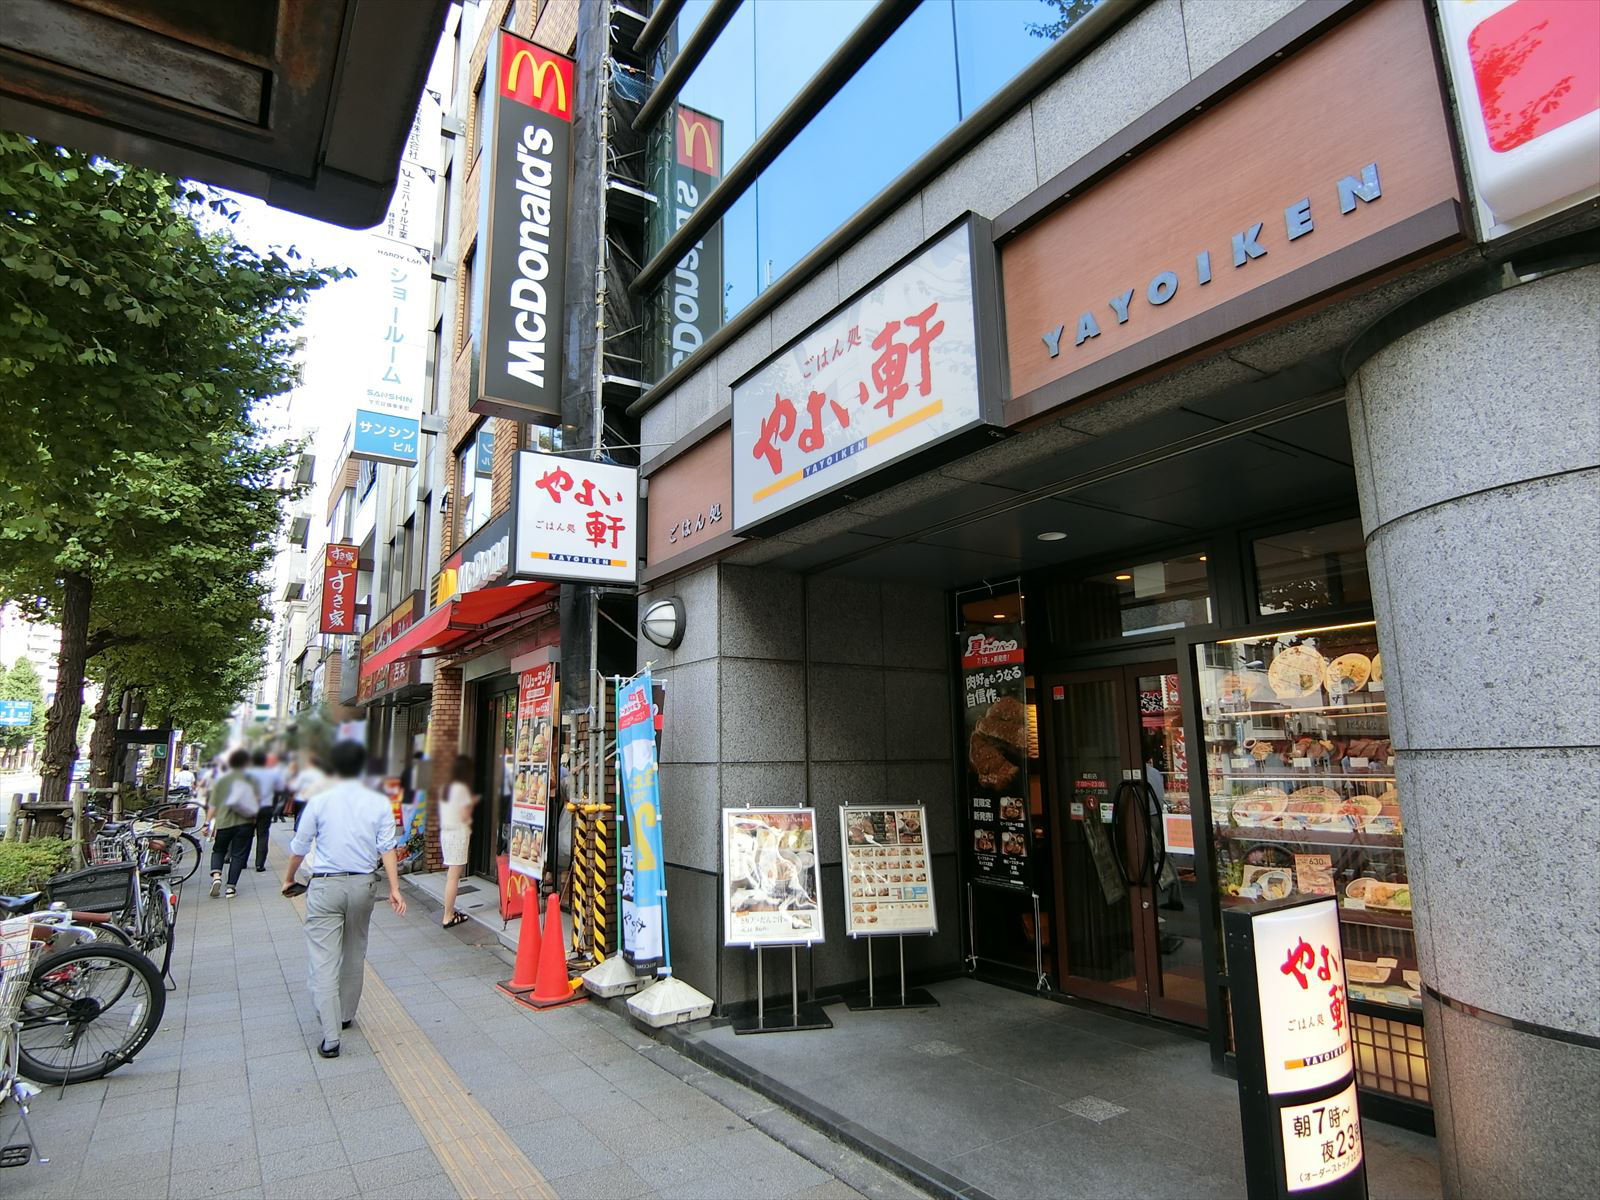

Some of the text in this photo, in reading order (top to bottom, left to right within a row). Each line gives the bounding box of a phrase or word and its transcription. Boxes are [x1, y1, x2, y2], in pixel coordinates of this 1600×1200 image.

[507, 125, 554, 388] McDonald's
[1041, 162, 1382, 359] YAYOIKEN
[382, 267, 407, 385] ショールーム
[803, 325, 862, 380] ごはん処
[367, 389, 413, 403] SANSHIN
[752, 302, 945, 475] やよい軒
[359, 420, 415, 440] サンシン
[393, 441, 414, 453] ビル
[804, 439, 866, 477] YAYOIKEN
[535, 465, 623, 506] やよい
[535, 520, 576, 534] ごはん処
[585, 510, 626, 549] 軒
[669, 503, 722, 544] ごはん処
[331, 547, 354, 562] すき家
[551, 553, 609, 566] YAYOIKEN
[328, 569, 353, 629] すき家
[965, 665, 1022, 690] 肉好きもうなる
[966, 688, 1001, 708] 自信作。
[1287, 1014, 1325, 1031] ごはん処
